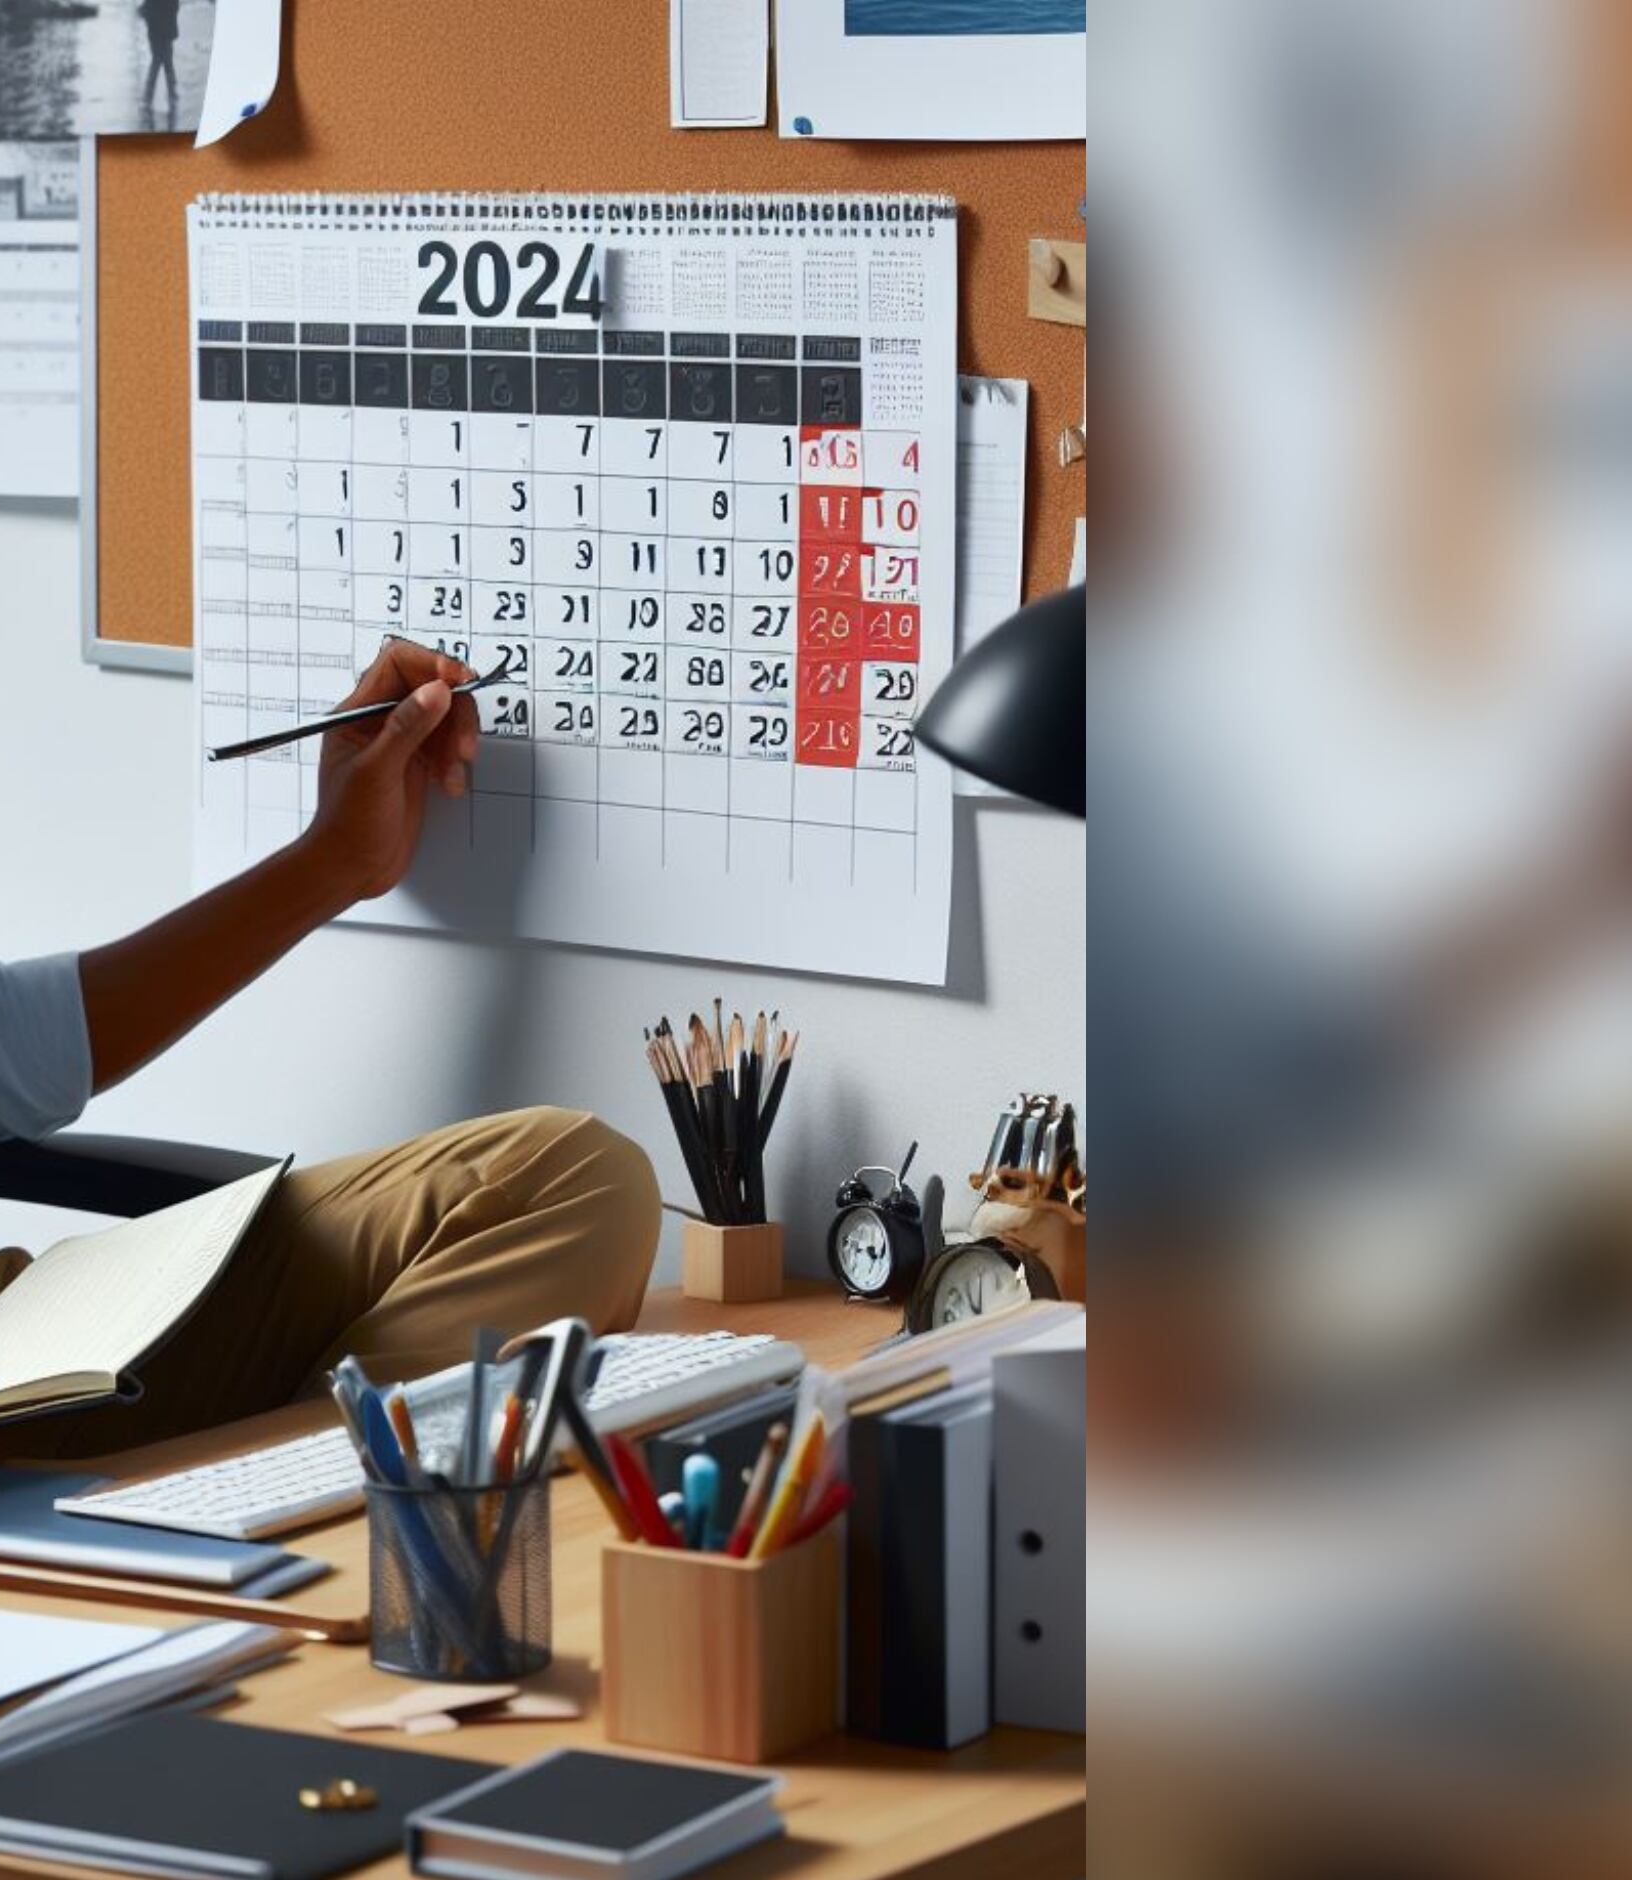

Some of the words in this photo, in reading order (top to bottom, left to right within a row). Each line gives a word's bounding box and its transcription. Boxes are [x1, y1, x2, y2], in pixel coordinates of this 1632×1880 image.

[417, 241, 603, 322] 2024
[450, 420, 461, 453] 1
[575, 424, 595, 457] 7
[644, 427, 663, 460] 7
[712, 430, 731, 465] 7
[781, 434, 792, 467] 1
[450, 477, 461, 510] 1
[510, 480, 528, 512] 5
[573, 483, 584, 517] 1
[647, 486, 658, 518] 1
[778, 492, 789, 524] 1
[876, 499, 917, 531] 10
[335, 526, 344, 557] 1
[450, 532, 461, 566] 1
[631, 541, 657, 575] 11
[759, 548, 794, 581] 10
[627, 596, 659, 631] 10
